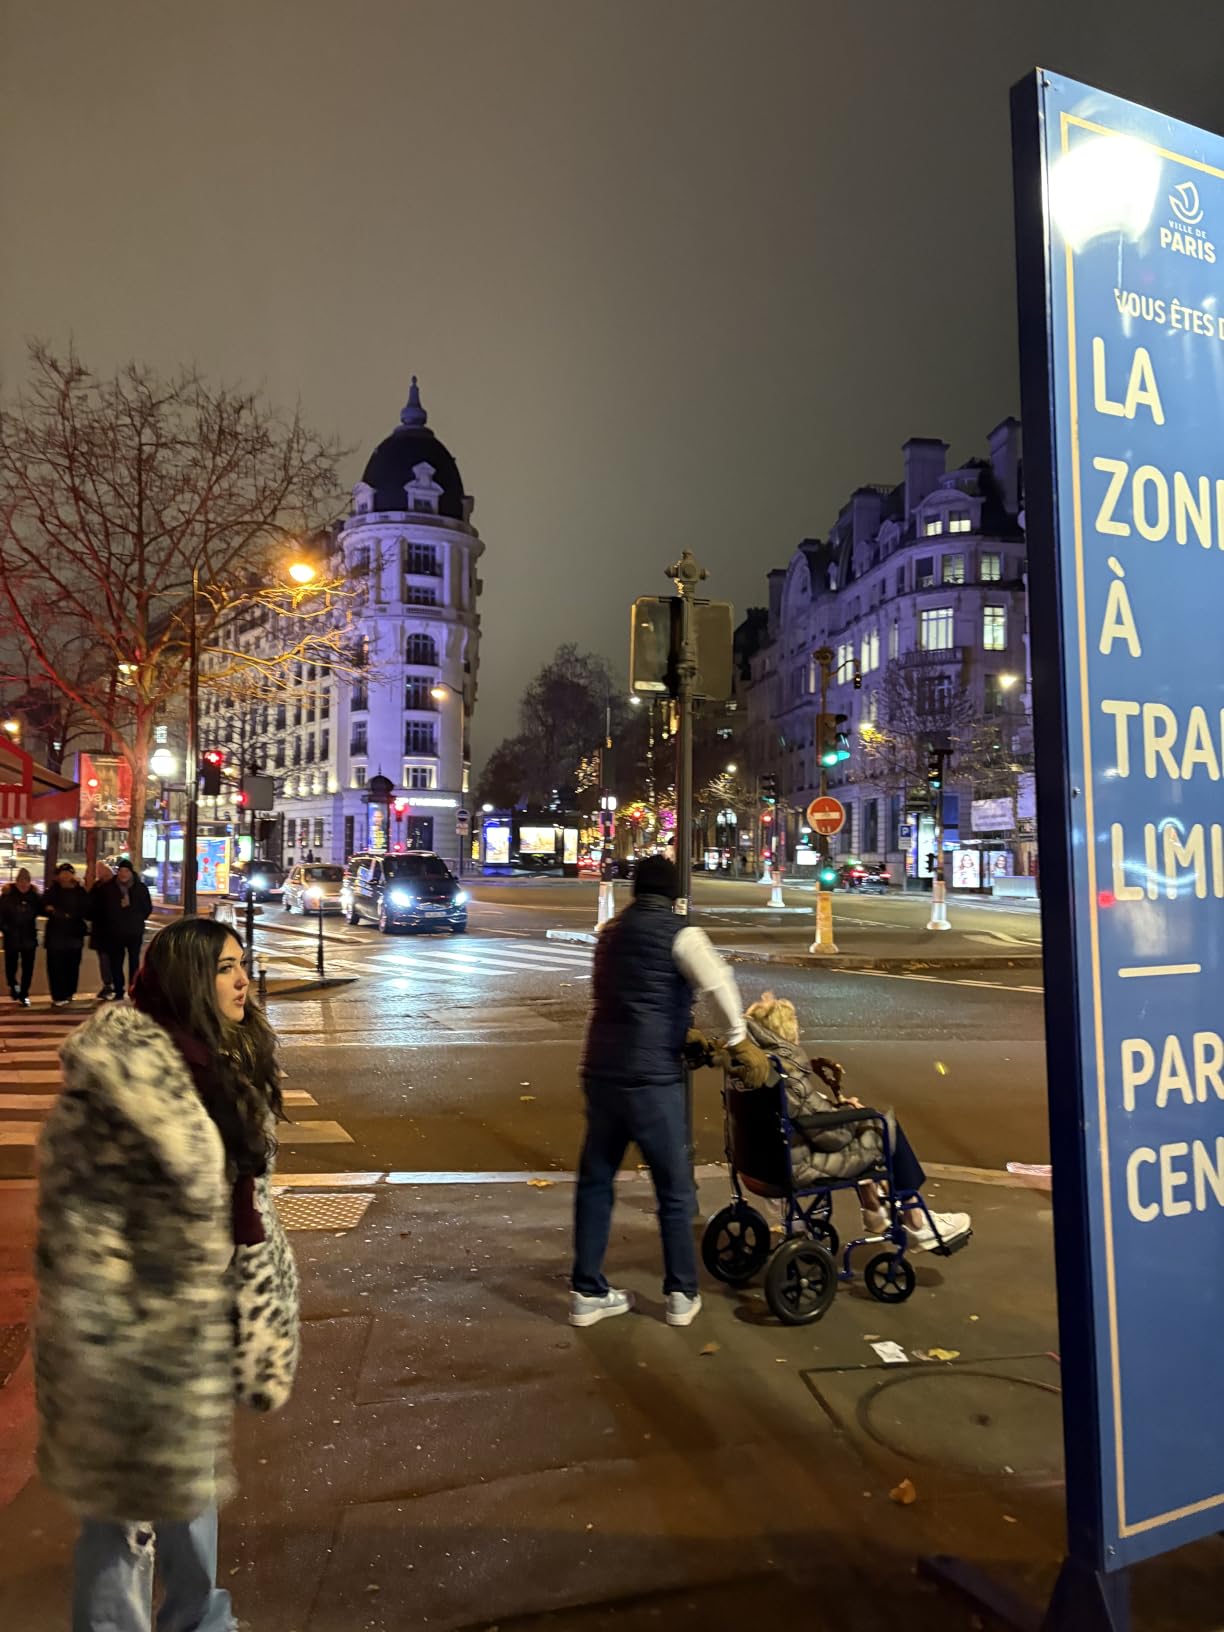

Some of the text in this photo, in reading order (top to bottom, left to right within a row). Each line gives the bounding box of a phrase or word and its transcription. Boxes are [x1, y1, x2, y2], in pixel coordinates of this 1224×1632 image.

[1159, 227, 1217, 264] PARIS
[1168, 219, 1207, 240] VILLE DE
[1113, 288, 1167, 325] VOUS
[1170, 298, 1215, 338] ÊTES
[1092, 336, 1166, 426] LA
[1099, 556, 1142, 658] À
[1100, 699, 1224, 782] TRA
[1120, 1031, 1224, 1112] PAR
